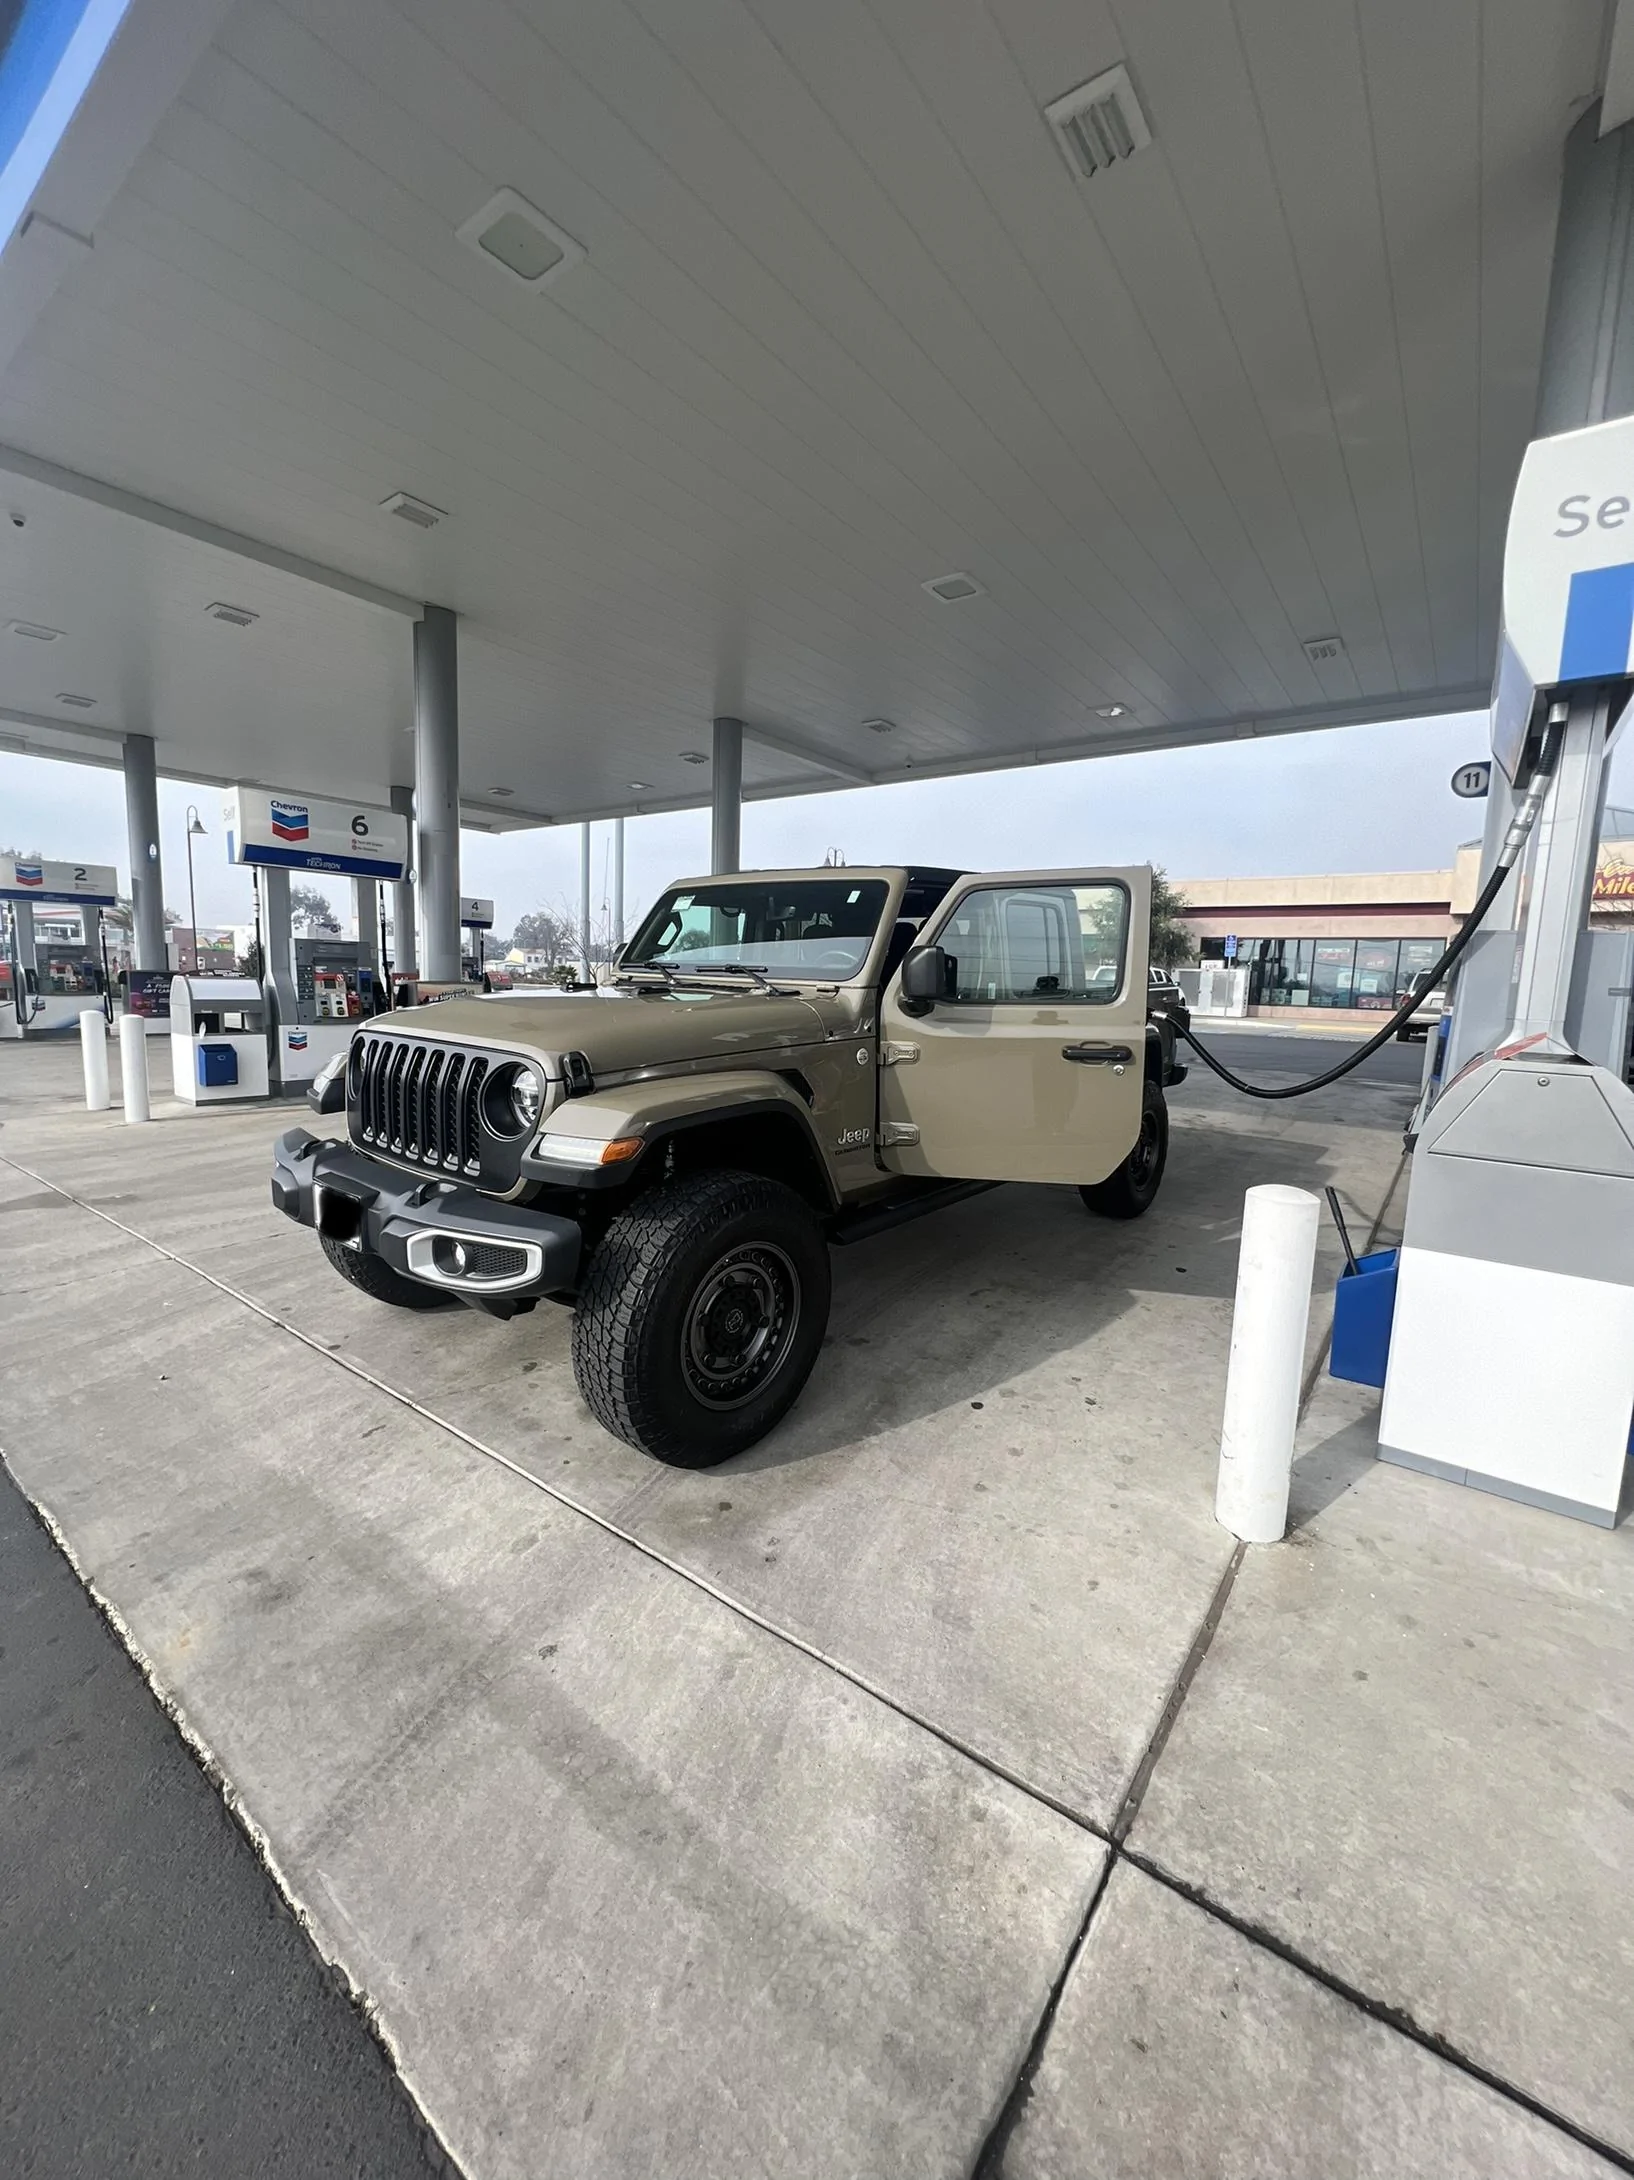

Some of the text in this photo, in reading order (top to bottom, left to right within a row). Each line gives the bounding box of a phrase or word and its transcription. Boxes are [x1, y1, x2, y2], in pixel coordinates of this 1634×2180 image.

[1553, 495, 1630, 537] Se
[1463, 772, 1480, 789] 11
[270, 800, 308, 812] Chevron
[351, 815, 369, 836] 6
[74, 868, 87, 881] 2
[471, 901, 479, 911] 4
[837, 1128, 870, 1144] Jeep
